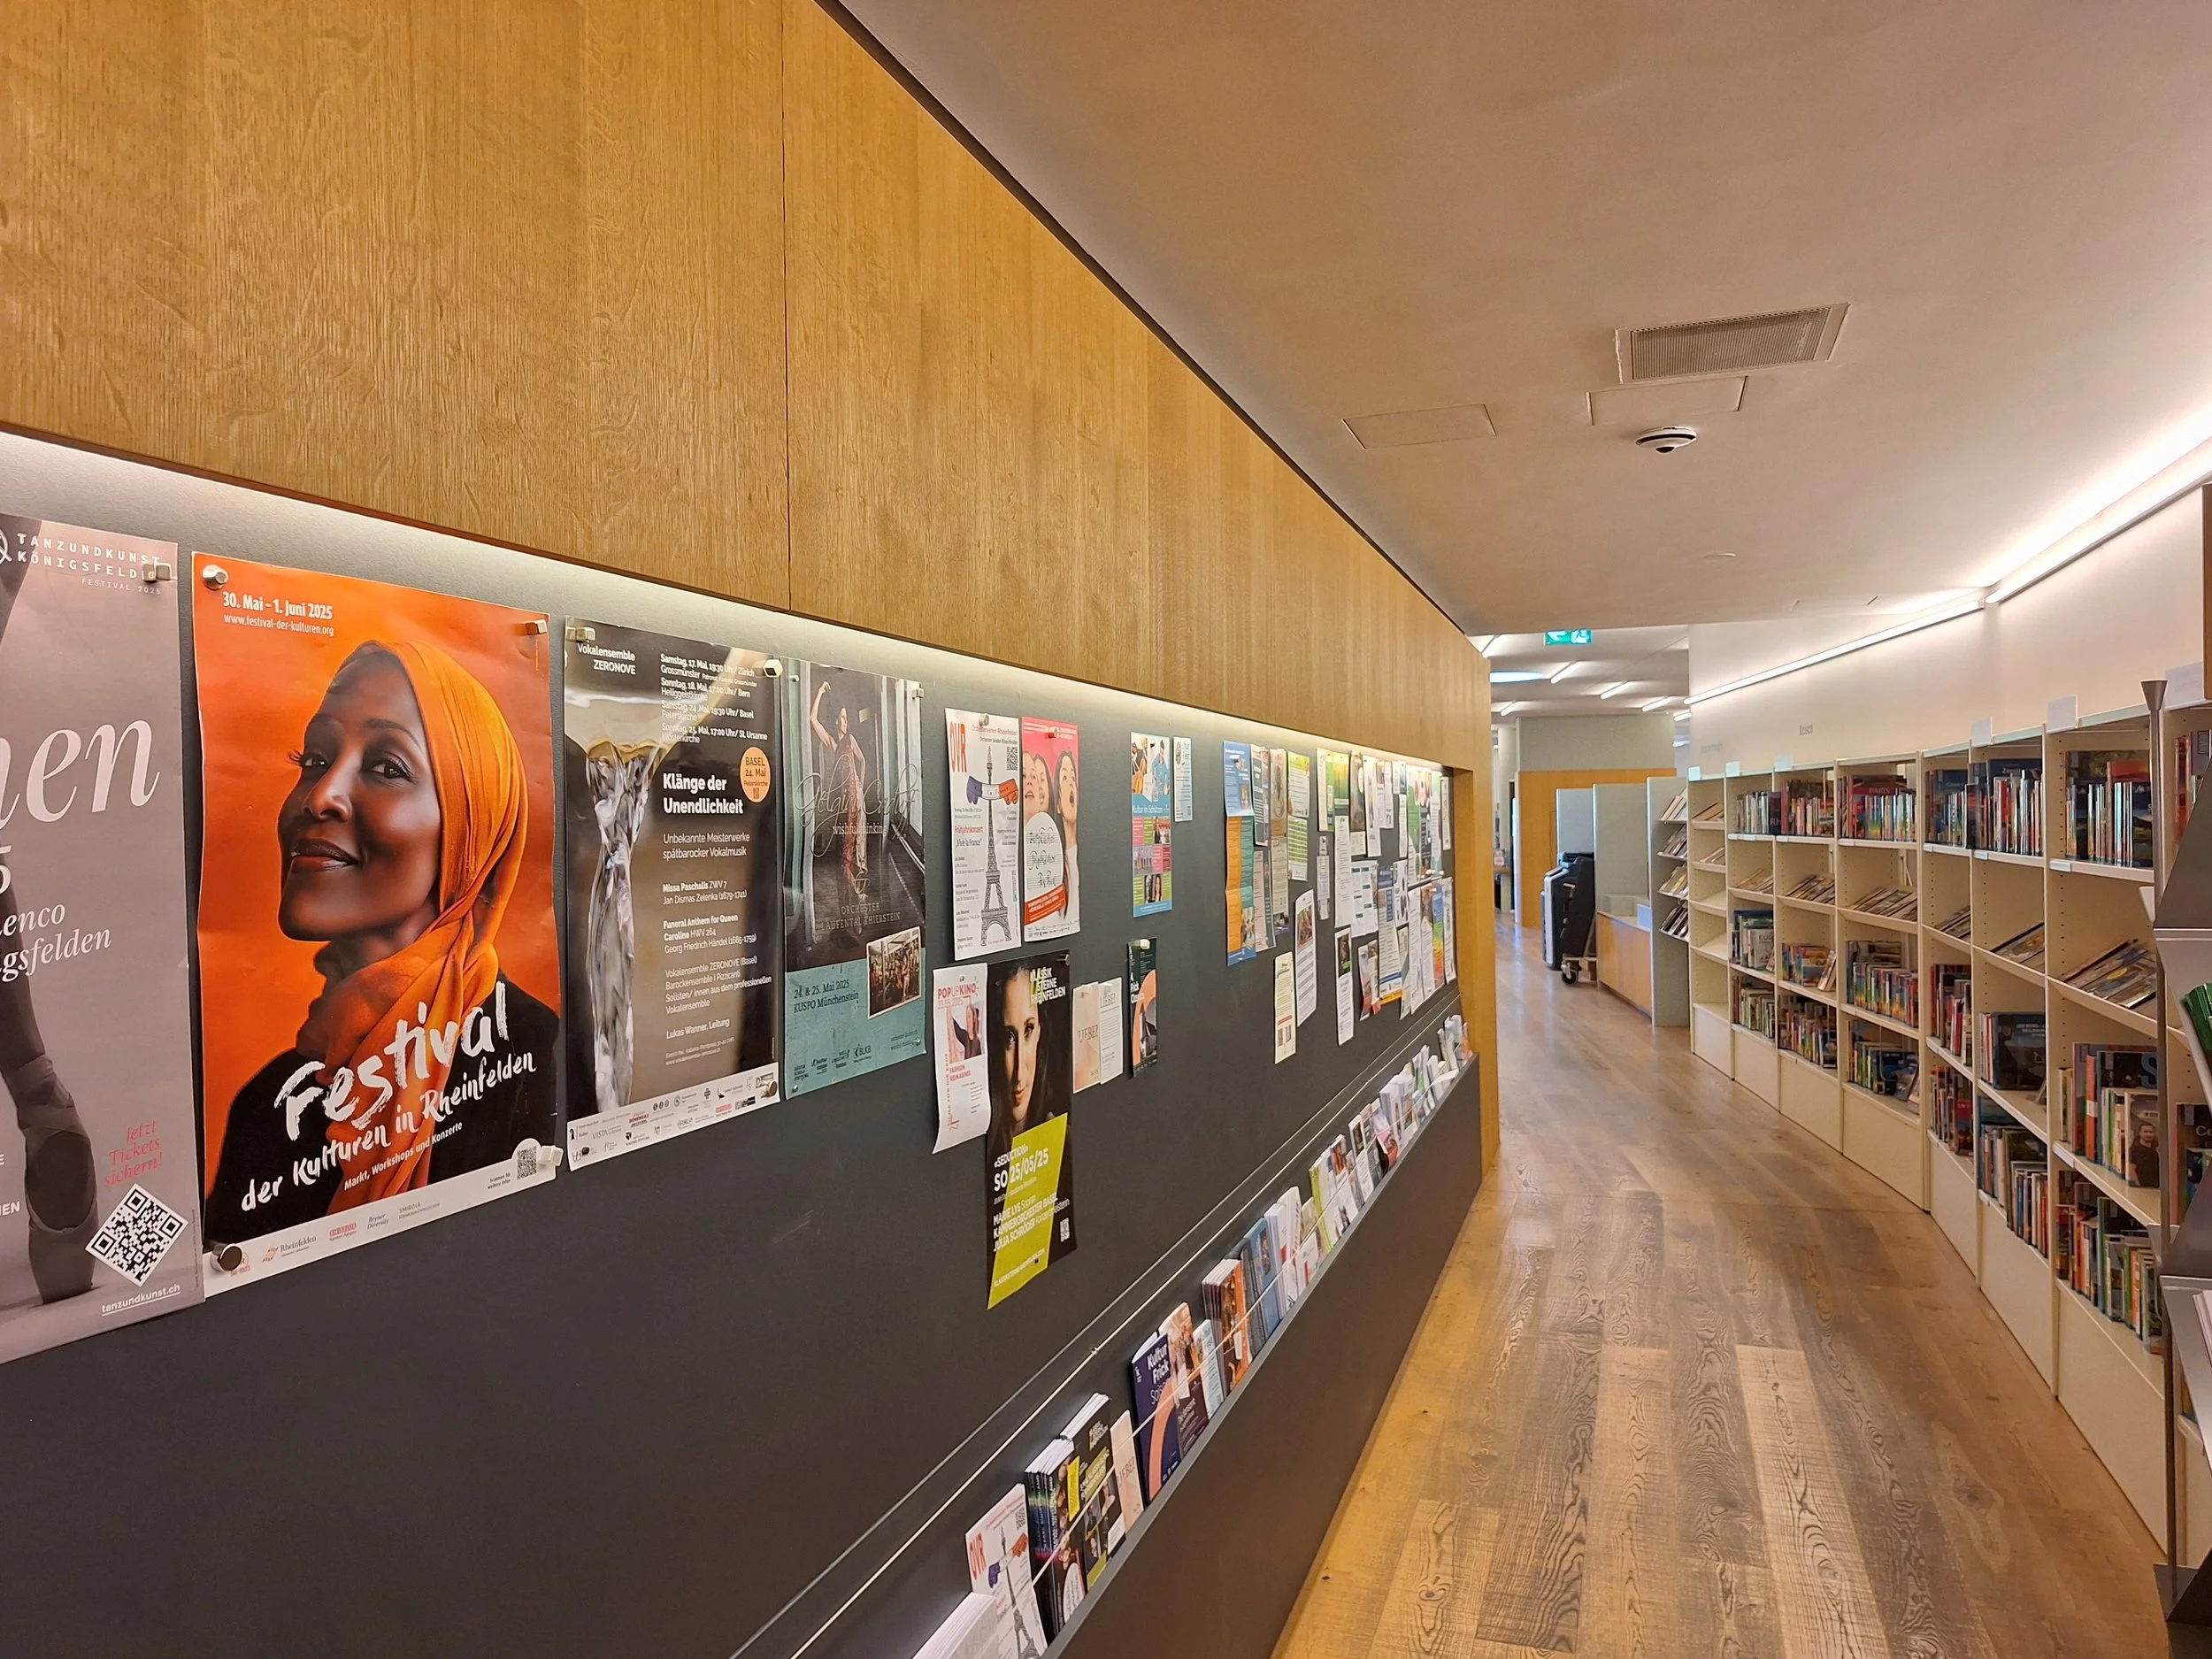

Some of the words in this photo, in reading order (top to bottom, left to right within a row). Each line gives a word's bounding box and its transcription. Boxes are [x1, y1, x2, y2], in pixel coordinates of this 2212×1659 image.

[17, 533, 160, 567] TANZUNDKUNST
[17, 550, 156, 583] KÖNIGSFELD
[81, 578, 131, 591] FESTIVAL
[137, 586, 161, 595] 2025
[222, 591, 241, 609] 30.
[242, 594, 264, 612] Mai
[273, 598, 283, 614] 1.
[284, 600, 306, 618] Juni
[307, 603, 333, 620] 2025
[223, 613, 334, 637] www.festival-der-kulturen.org
[578, 642, 636, 662] Vokalensemble
[660, 653, 687, 667] Samstag,
[593, 659, 636, 675] ZERONOVE
[660, 664, 701, 679] Grossmünster
[660, 677, 687, 690] Sonntag,
[739, 709, 755, 719] Basel
[746, 730, 768, 741] Ursanne
[949, 721, 967, 772] OVR
[745, 757, 765, 766] BASEL
[755, 767, 766, 777] Mai
[663, 772, 705, 794] Klänge
[707, 775, 727, 791] der
[663, 796, 744, 815] Unendlichkeit
[663, 833, 706, 844] Unbekannte
[706, 832, 750, 843] Meisterwerke
[832, 822, 857, 835] wishful
[662, 847, 709, 862] spätbarocker
[709, 845, 747, 857] Vokalmusik
[662, 883, 680, 893] Missa
[680, 880, 709, 892] Paschalis
[709, 879, 723, 889] ZWV
[663, 895, 673, 905] Jan
[674, 895, 695, 904] Dismas
[695, 893, 718, 902] Zelenka
[841, 902, 880, 915] ORCHESTER
[0, 903, 66, 937] enco
[663, 918, 687, 930] Funeral
[687, 917, 710, 927] Anthem
[710, 915, 719, 925] for
[719, 914, 738, 924] Queen
[820, 918, 862, 931] LAUFENTAL
[863, 912, 902, 926] THIERSTEIN
[664, 931, 689, 942] Caroline
[690, 929, 705, 939] HWV
[705, 927, 717, 937] 264
[664, 944, 683, 954] Georg
[683, 940, 708, 951] Friedrich
[708, 936, 727, 949] Händel
[0, 928, 112, 983] gsfelden
[665, 964, 709, 979] Vokalensemble
[710, 958, 741, 972] ZERONOVE
[741, 955, 758, 966] (Basel)
[665, 976, 713, 991] Barockensemble
[710, 985, 720, 994] aus
[720, 982, 733, 993] dem
[733, 976, 772, 991] professionellen
[794, 984, 804, 999] 24.
[804, 987, 811, 996] &
[811, 985, 822, 995] 25.
[823, 980, 834, 993] Mai
[835, 979, 850, 990] 2025
[1037, 977, 1057, 992] STERNE
[665, 999, 710, 1015] Vokalensemble
[794, 999, 817, 1013] KUSPO
[817, 991, 859, 1008] Münchenstein
[666, 1027, 684, 1040] Lukas
[684, 1023, 709, 1035] Wanner,
[709, 1018, 730, 1030] Leitung
[274, 979, 510, 1142] Festival
[241, 1174, 283, 1212] der
[293, 1125, 391, 1187] Kulturen
[396, 1103, 419, 1133] in
[419, 1051, 537, 1126] Rheinfelden
[109, 1138, 160, 1165] Tickets
[344, 1173, 370, 1191] Markt,
[371, 1147, 414, 1177] Workshops
[415, 1142, 430, 1156] und
[431, 1121, 463, 1149] Konzerte
[104, 1151, 163, 1187] sichern!
[994, 1170, 1008, 1192] SO
[1009, 1147, 1049, 1184] 25/05/25
[280, 1235, 317, 1253] Rheinfelden
[101, 1283, 180, 1314] tanzundkunst.ch
[1147, 1342, 1168, 1371] Kultur
[1152, 1359, 1170, 1385] Frick
